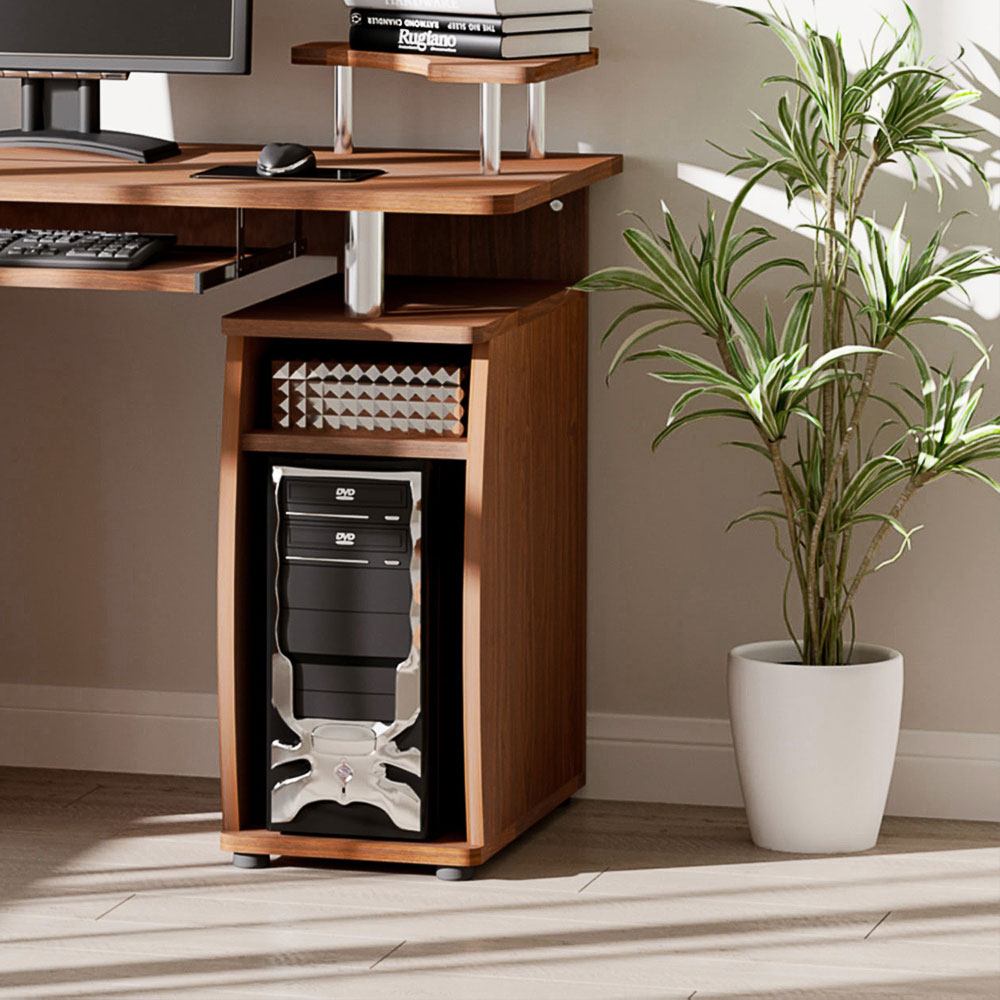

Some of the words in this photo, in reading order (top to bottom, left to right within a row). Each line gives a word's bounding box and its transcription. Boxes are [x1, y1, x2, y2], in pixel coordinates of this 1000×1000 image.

[367, 16, 403, 27] CHANDLER
[403, 18, 440, 29] RAYMOND
[468, 22, 481, 32] BIG
[482, 24, 496, 33] THE
[398, 28, 457, 51] Rugiano
[336, 488, 355, 497] DVD
[335, 532, 355, 542] DVD
